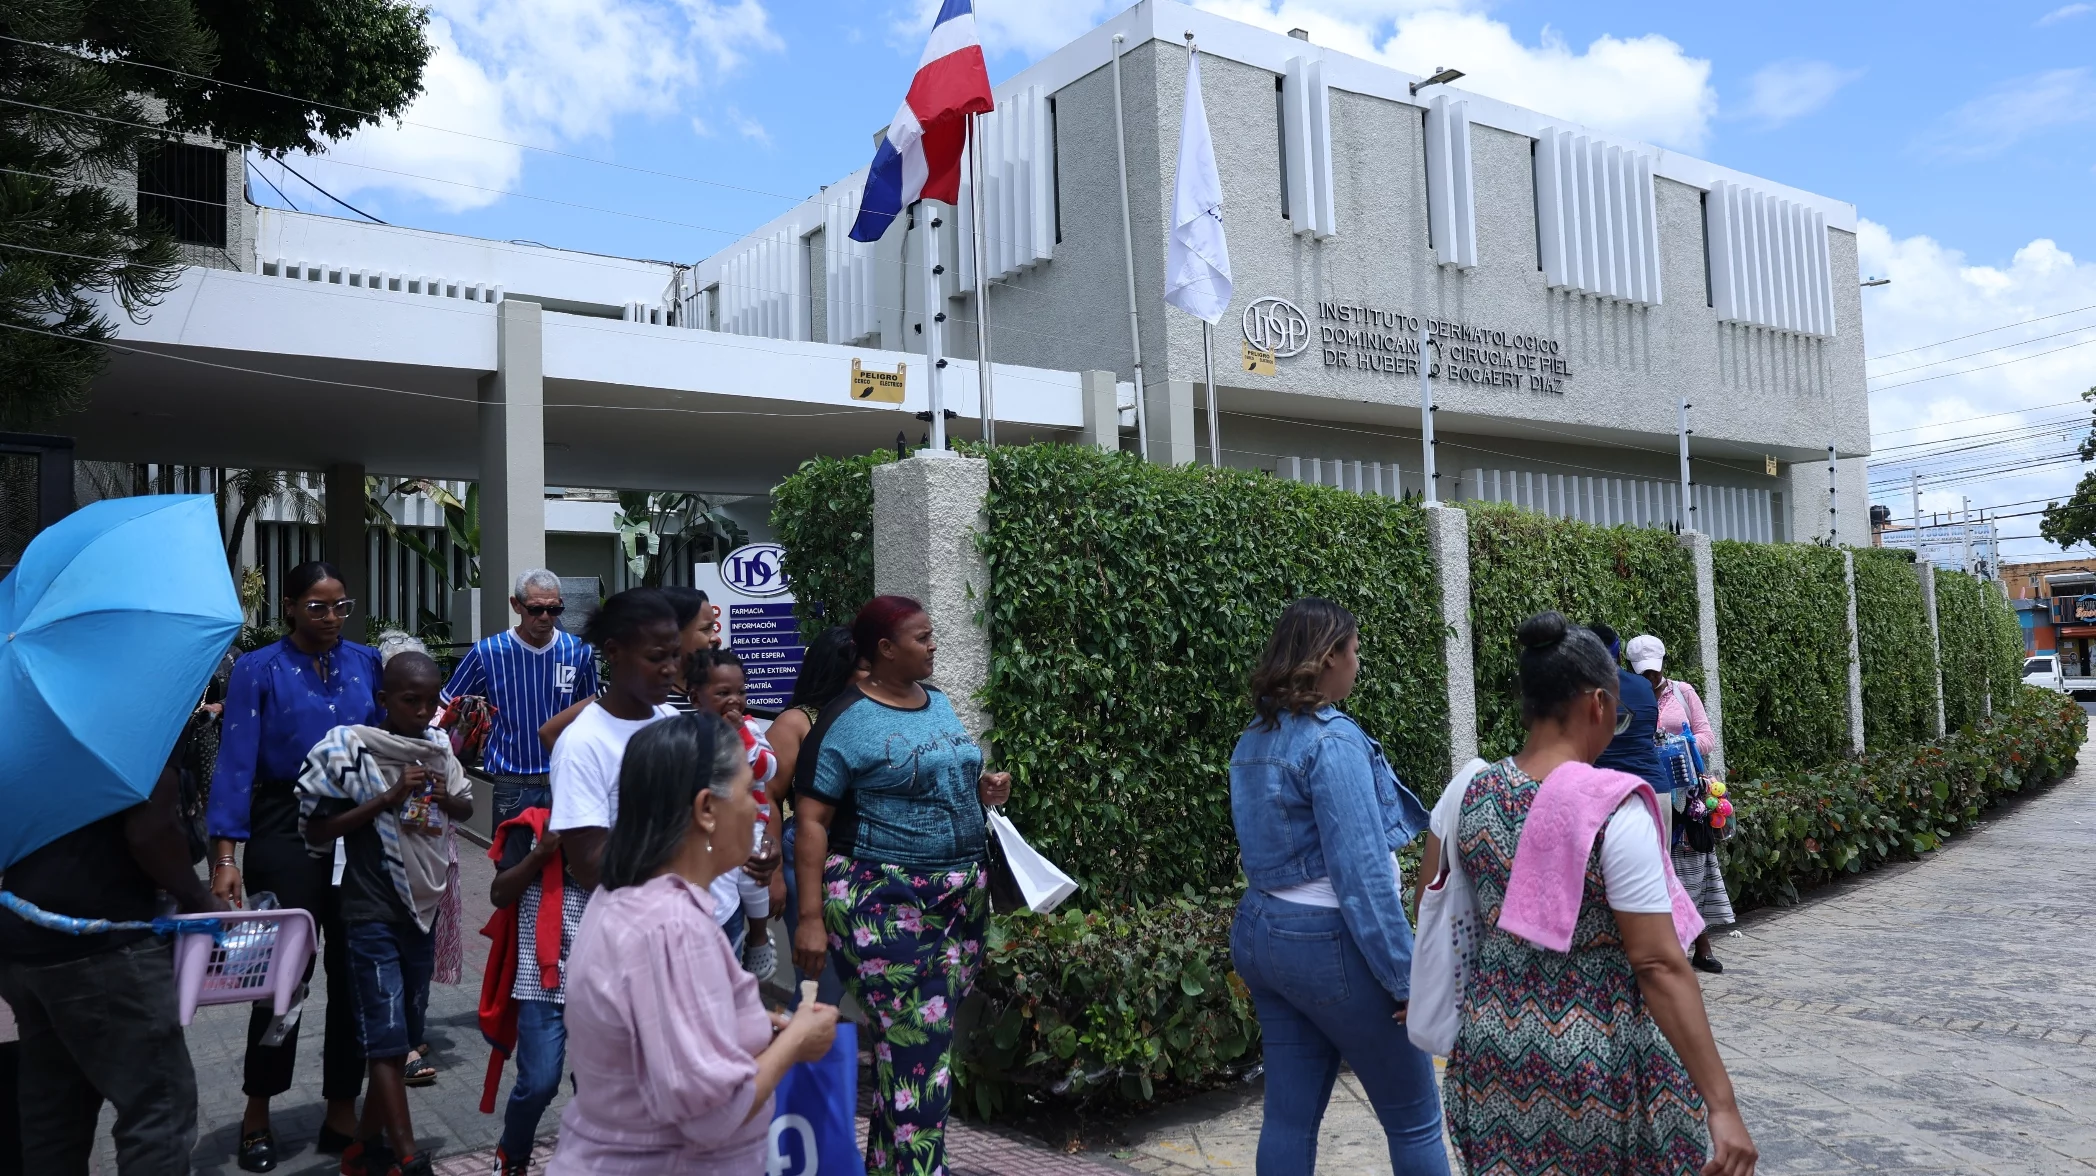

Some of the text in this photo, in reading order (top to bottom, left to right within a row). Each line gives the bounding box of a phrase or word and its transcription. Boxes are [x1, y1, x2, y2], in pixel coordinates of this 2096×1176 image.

[1318, 301, 1559, 355] INSTITUTO DERMATOLOGICO
[1321, 326, 1421, 356] DOMINICAN
[1434, 341, 1444, 358] Y
[1516, 353, 1537, 371] DE
[1540, 356, 1573, 376] PIEL
[1323, 348, 1350, 367] DR.
[1358, 352, 1442, 378] HUBERO
[1530, 374, 1564, 394] DIAZ
[860, 371, 898, 381] PELIGRO
[731, 621, 777, 630] INFORMACIÓN
[732, 636, 750, 645] ÁREA
[746, 666, 796, 675] SULTA EXTERNA
[746, 697, 783, 705] ORATORIOS
